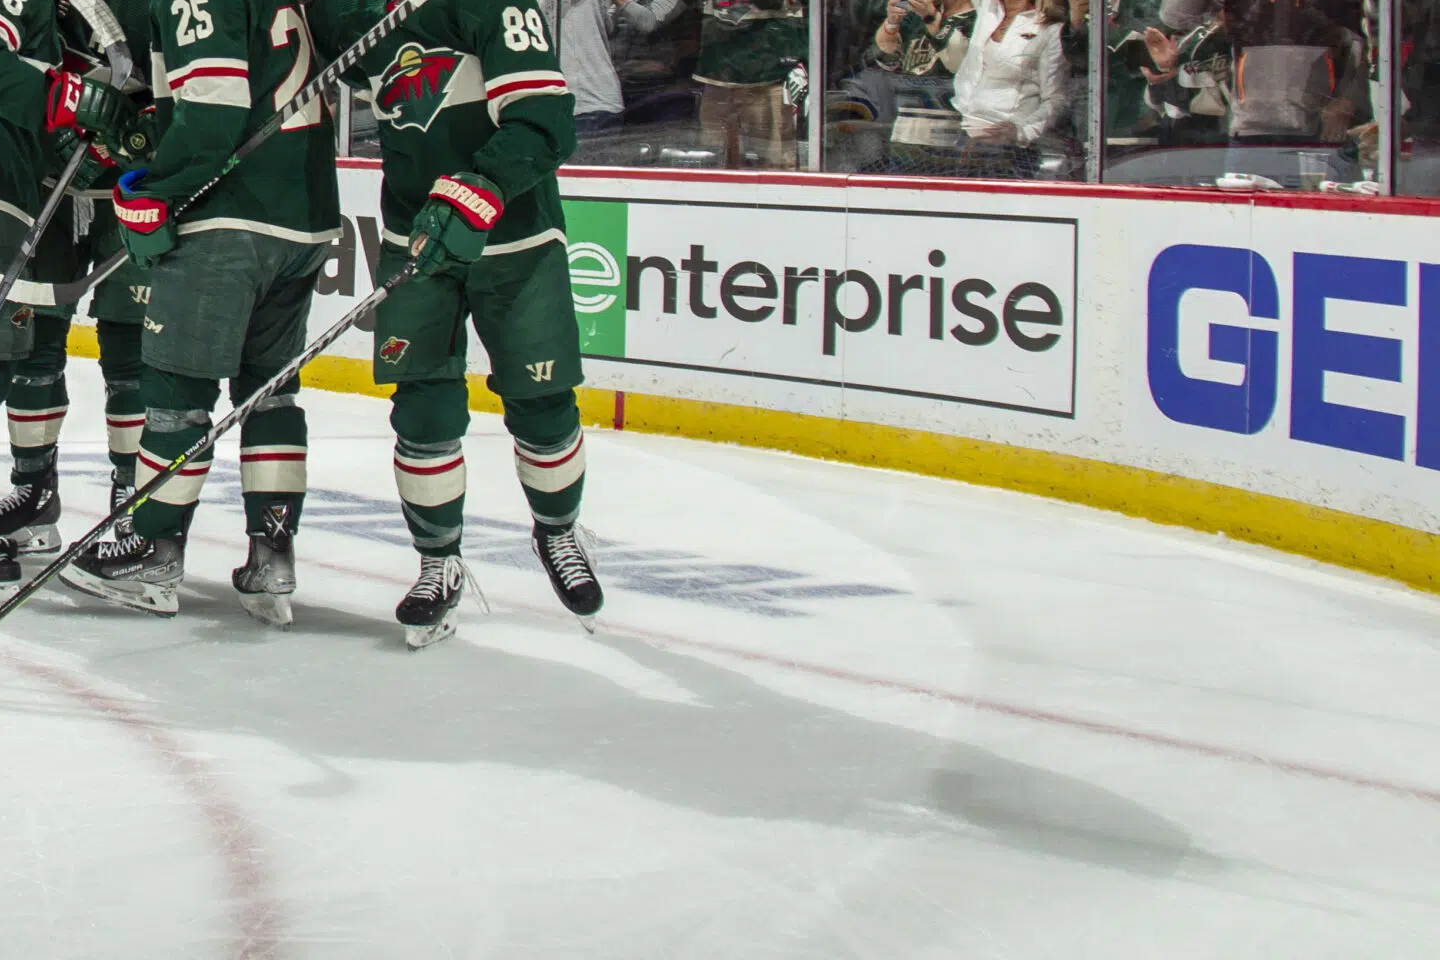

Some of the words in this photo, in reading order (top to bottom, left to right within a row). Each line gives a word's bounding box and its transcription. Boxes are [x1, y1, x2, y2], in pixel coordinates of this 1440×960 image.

[502, 6, 549, 52] 89
[567, 242, 1064, 356] enterprise
[185, 437, 207, 457] ALPHA
[112, 563, 143, 577] BAUER
